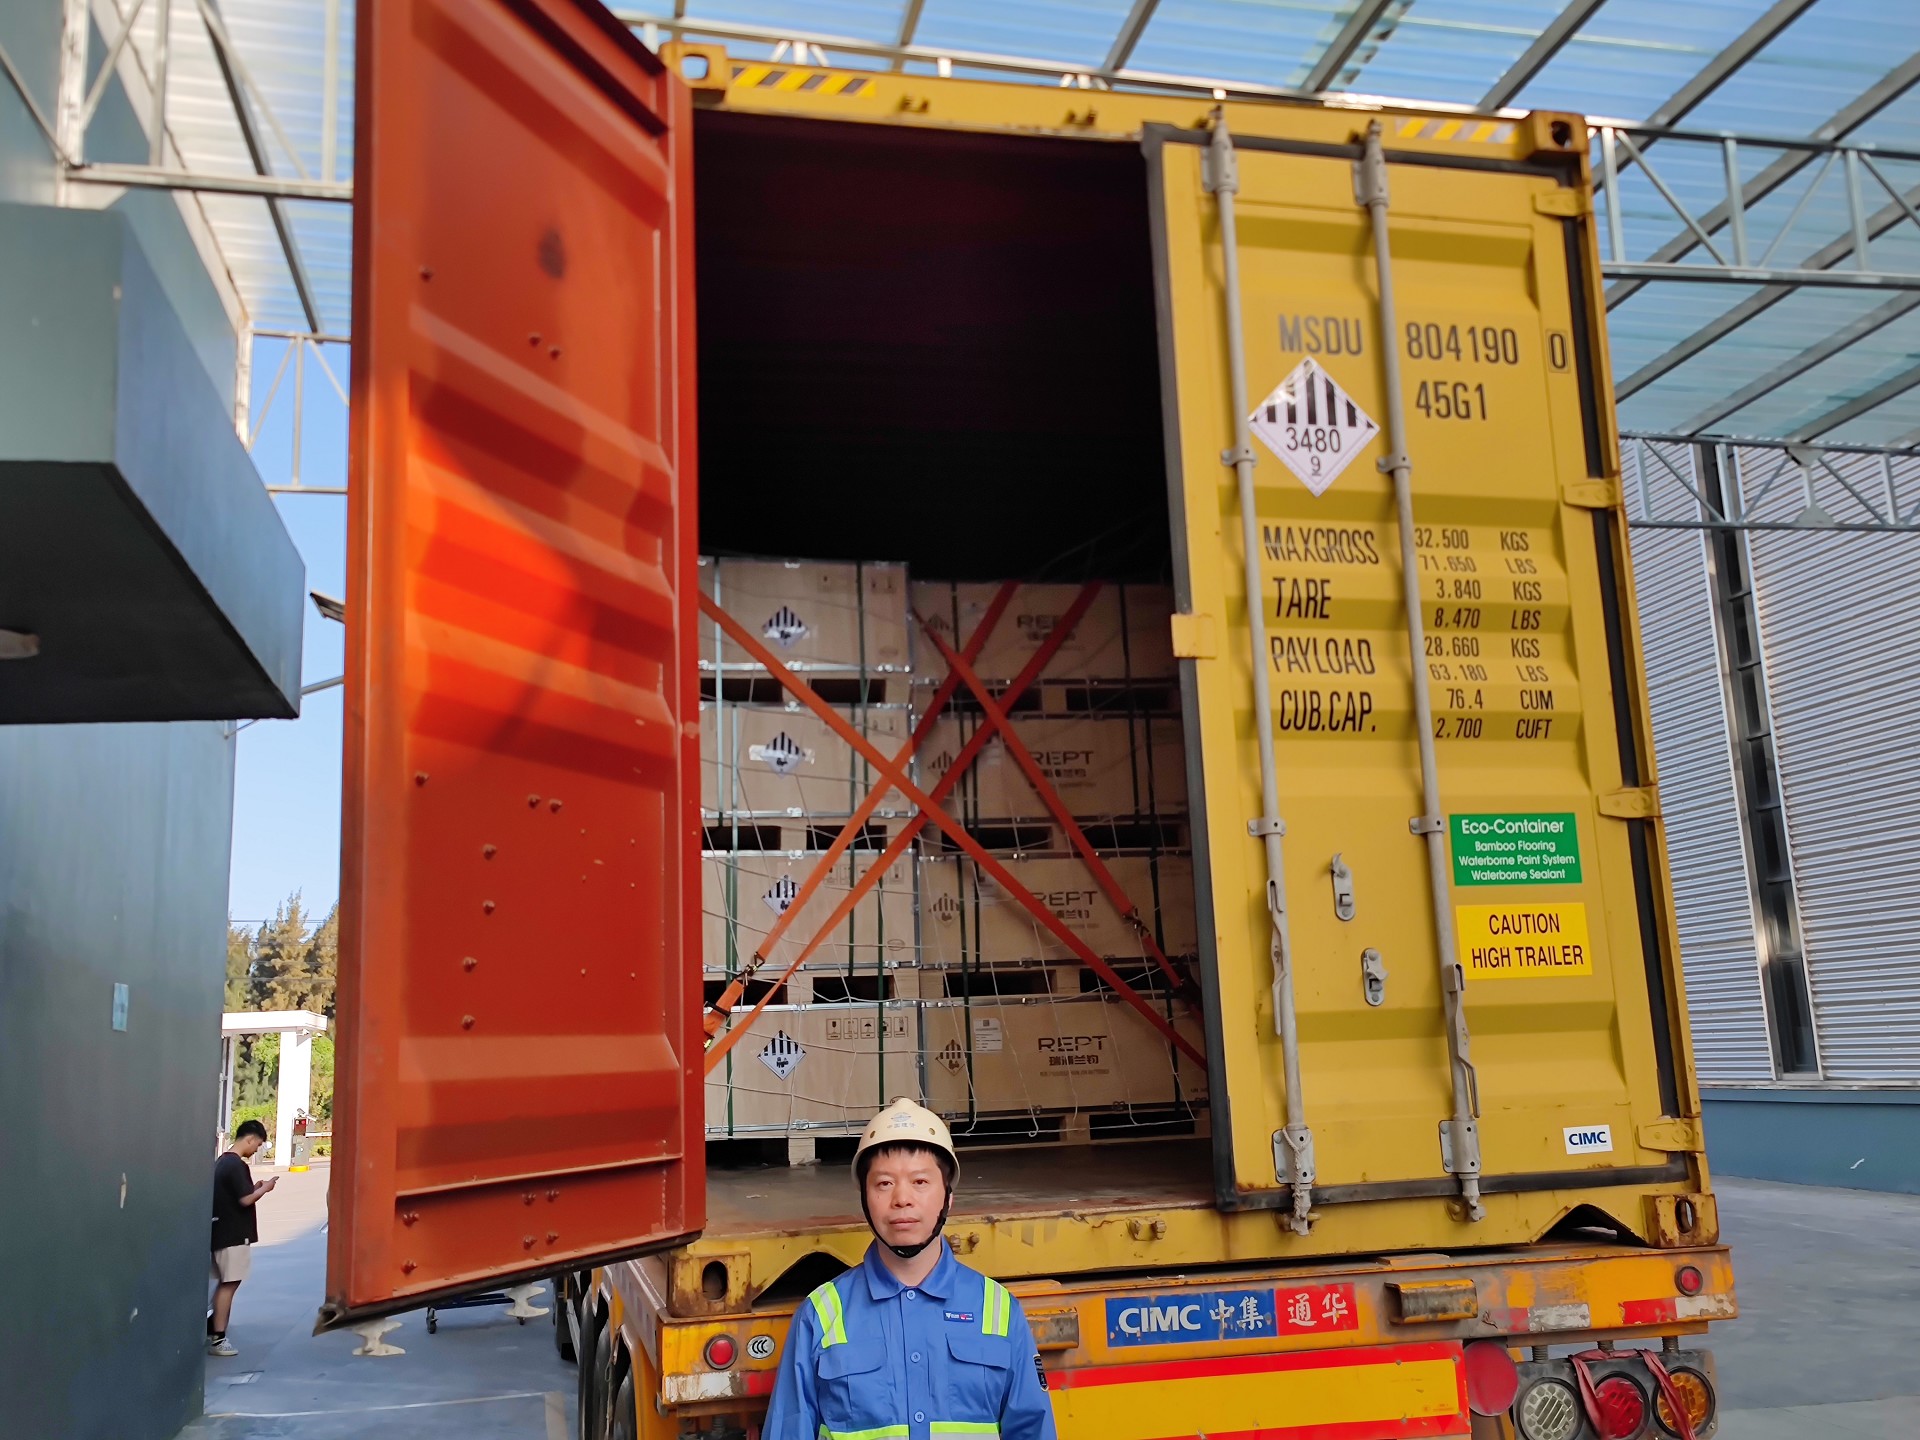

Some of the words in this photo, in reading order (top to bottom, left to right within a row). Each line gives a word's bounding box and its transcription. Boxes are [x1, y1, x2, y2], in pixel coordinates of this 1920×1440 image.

[1279, 315, 1363, 356] MSDU
[1406, 322, 1519, 365] 804190
[1549, 333, 1567, 370] 0
[1415, 381, 1487, 421] 45G1
[1286, 427, 1342, 453] 3480
[1310, 456, 1322, 473] 9
[1263, 525, 1379, 565] MAXGROSS
[1500, 531, 1530, 552] KGS
[1505, 557, 1538, 575] LBS
[1273, 577, 1332, 619] TARE
[1512, 581, 1543, 601] KGS
[1511, 609, 1541, 630] LBS
[1271, 636, 1376, 675] PAYLOAD
[1511, 638, 1540, 658] KGS
[1516, 665, 1549, 682] LBS
[1280, 690, 1376, 732] CUB.CAP.
[1446, 688, 1483, 710] 76.4
[1520, 689, 1554, 710] CUM
[1515, 718, 1553, 739] CUFT
[1461, 818, 1565, 835] Eco-Container
[1475, 840, 1516, 852] Bamboo
[1517, 840, 1556, 853] Flooring
[1458, 855, 1515, 867] Waterborne
[1517, 854, 1540, 866] Paint
[1542, 854, 1576, 867] System
[1471, 869, 1527, 881] Waterborne
[1529, 869, 1566, 880] Sealant
[1488, 913, 1561, 935] CAUTION
[1471, 946, 1512, 969] HIGH
[1515, 944, 1584, 968] TRAILER
[1038, 1035, 1108, 1052] REPT
[1568, 1131, 1607, 1146] CIMC
[1118, 1305, 1201, 1334] CIMC
[1287, 1292, 1348, 1326] 通华
